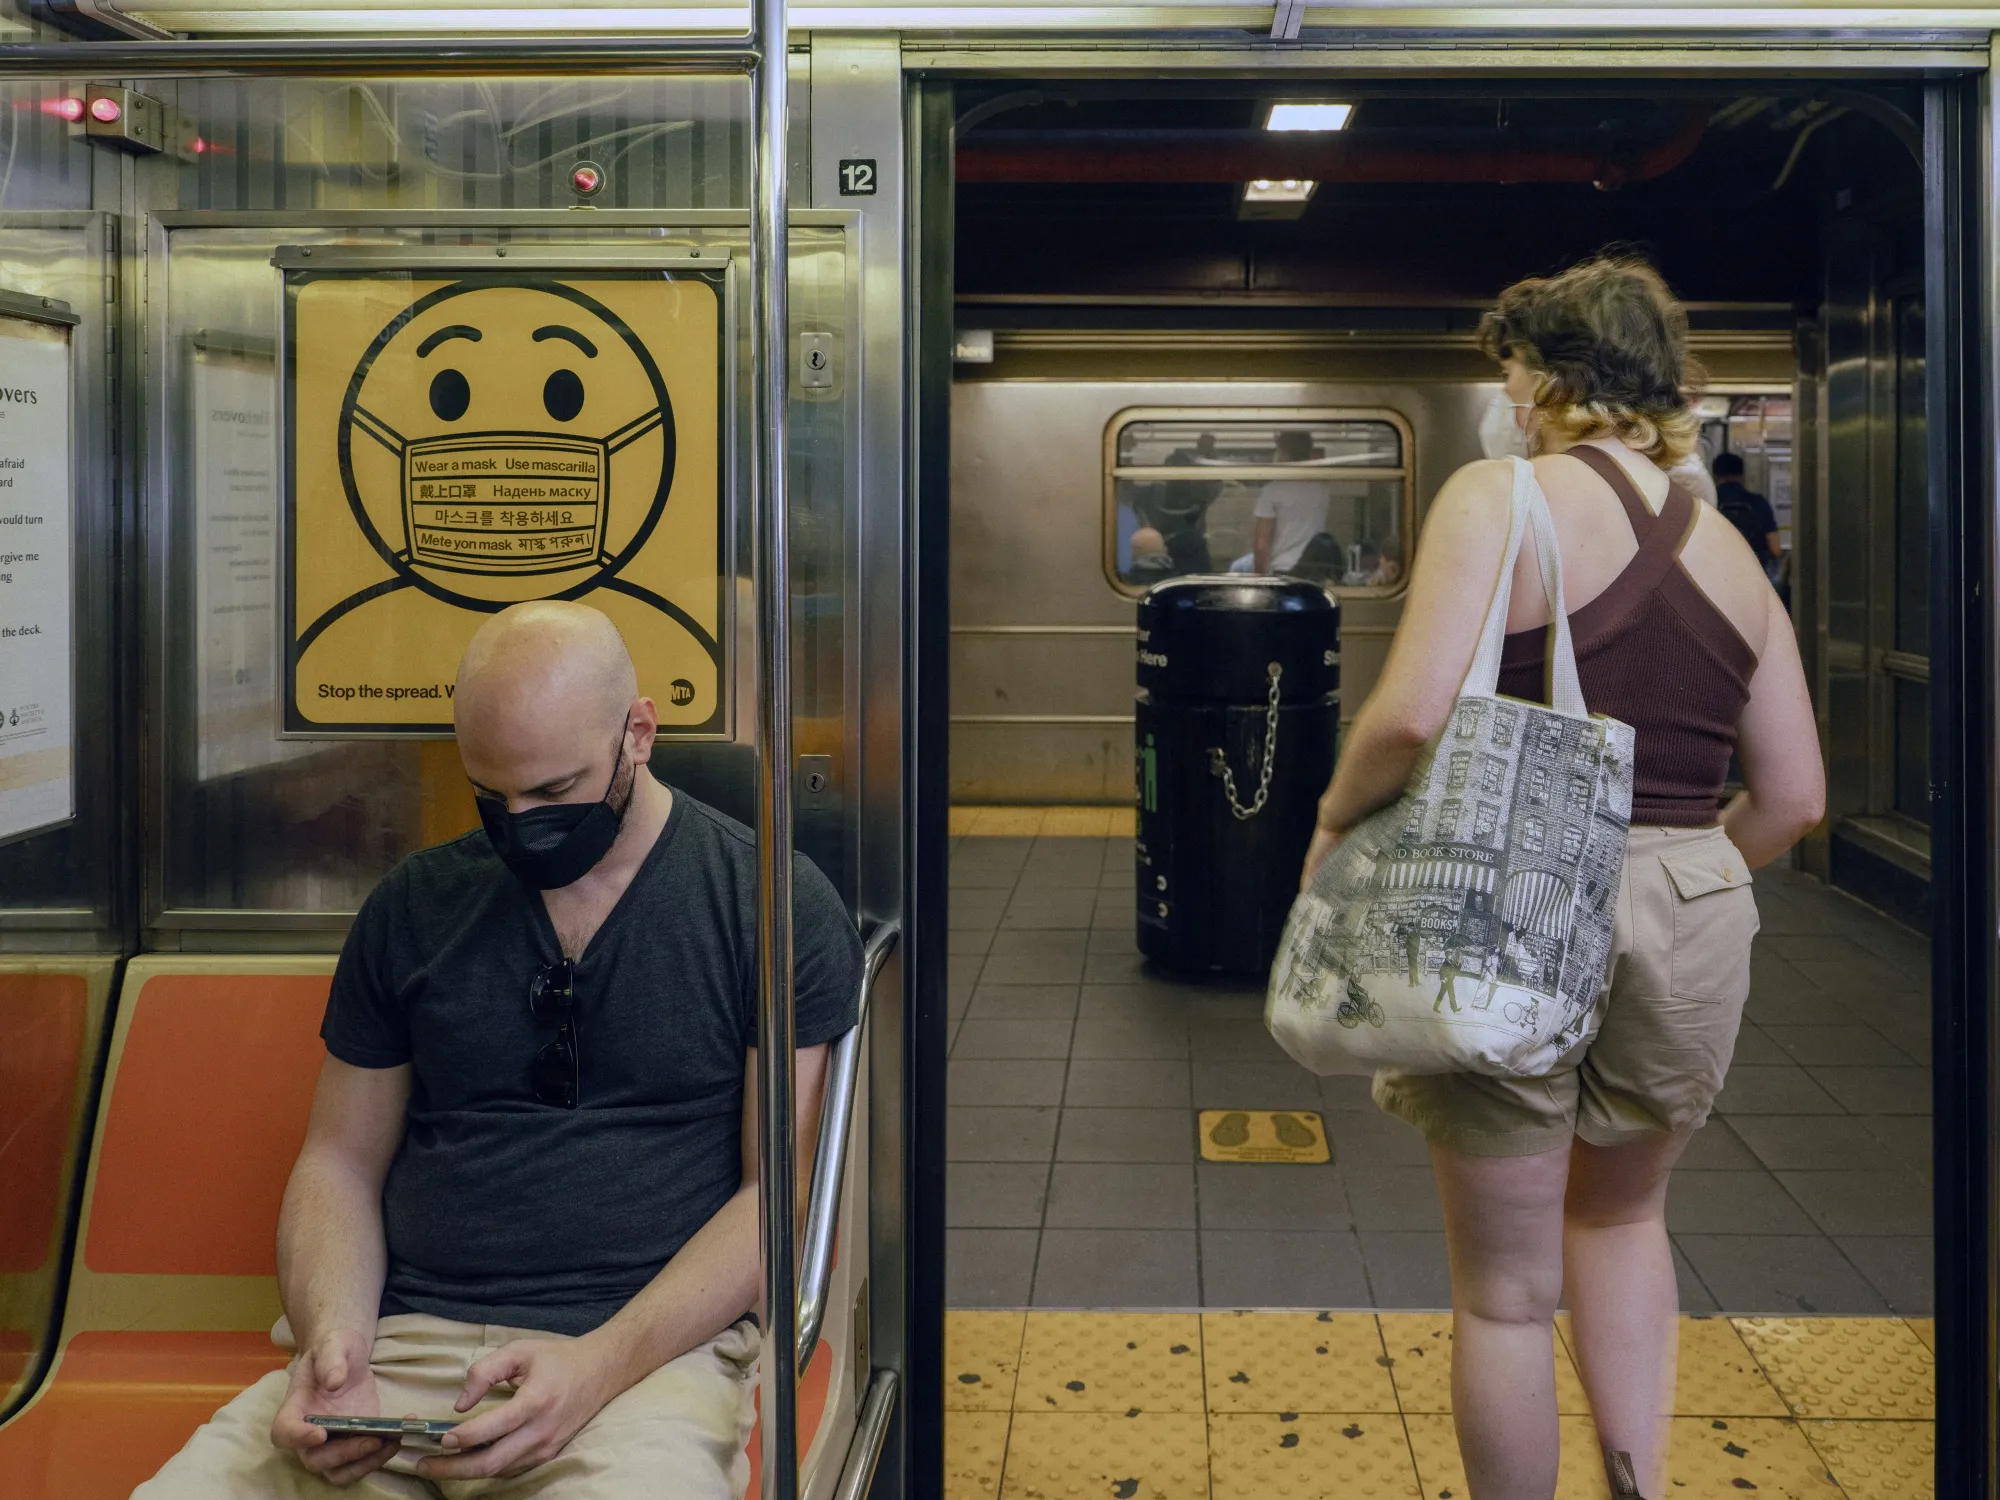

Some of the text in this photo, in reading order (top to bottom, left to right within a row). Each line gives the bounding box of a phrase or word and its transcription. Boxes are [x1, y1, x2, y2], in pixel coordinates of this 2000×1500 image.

[842, 165, 873, 190] 12
[0, 458, 25, 468] afraid
[415, 458, 497, 472] Wear a mask
[505, 458, 595, 473] Use mascarilla
[420, 485, 476, 498] 戴上口罩
[493, 485, 591, 500] Надень маску
[25, 515, 43, 525] turn
[435, 509, 574, 526] 마스크를 착용하세요
[421, 533, 512, 550] Mete yon mask
[26, 553, 39, 561] me
[2, 624, 42, 638] the deck.
[318, 684, 355, 700] Stop
[358, 684, 383, 698] the
[386, 684, 442, 700] spread.
[1413, 846, 1444, 859] BOOK
[1449, 847, 1494, 863] STORE
[1421, 917, 1453, 930] BOOKS
